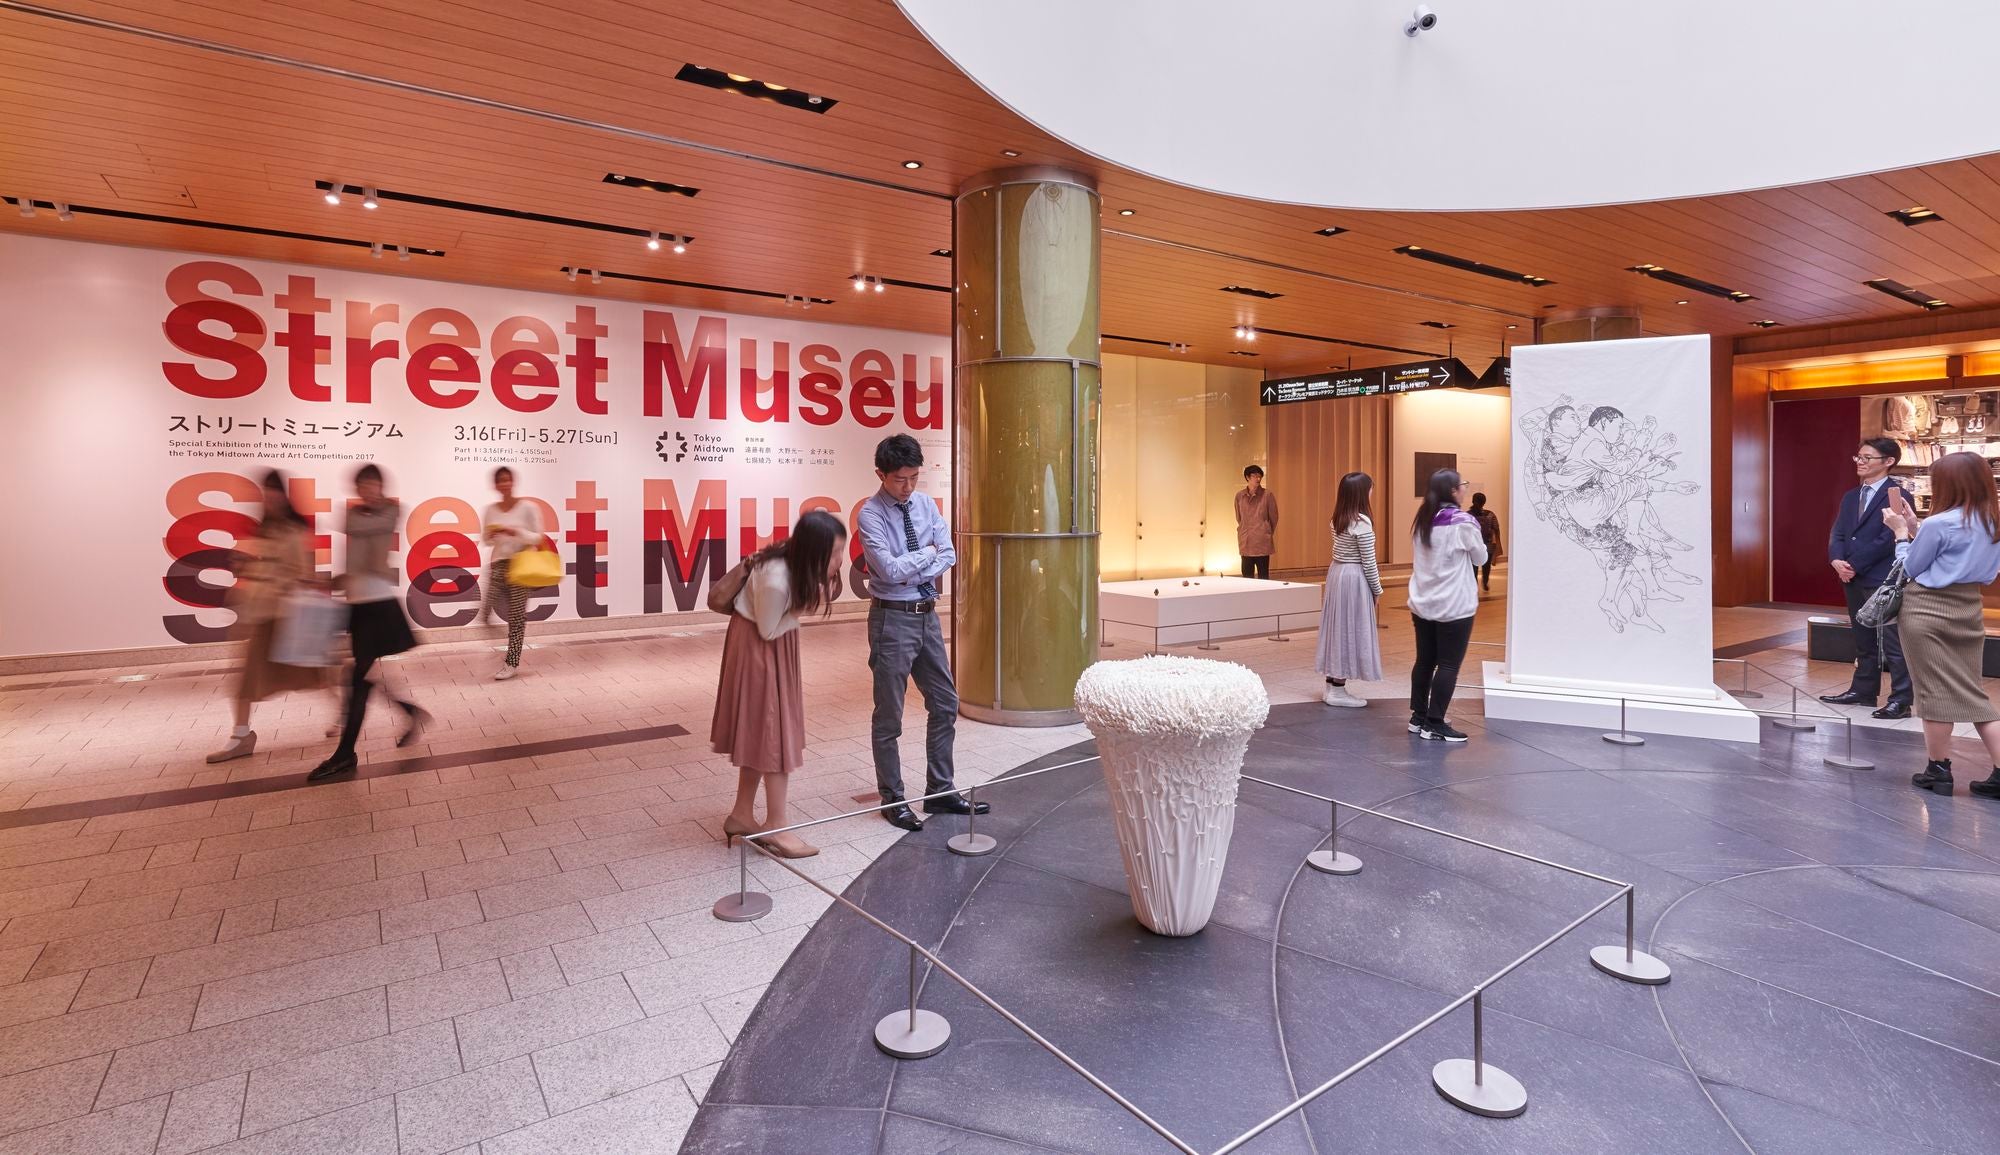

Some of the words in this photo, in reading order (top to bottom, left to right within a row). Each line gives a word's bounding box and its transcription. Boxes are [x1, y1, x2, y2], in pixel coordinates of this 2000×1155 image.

[162, 260, 609, 415] Street
[169, 415, 403, 438] ストリートミュージアム
[694, 434, 721, 443] Tokyo
[169, 440, 203, 448] Special
[187, 450, 214, 458] Tokyo
